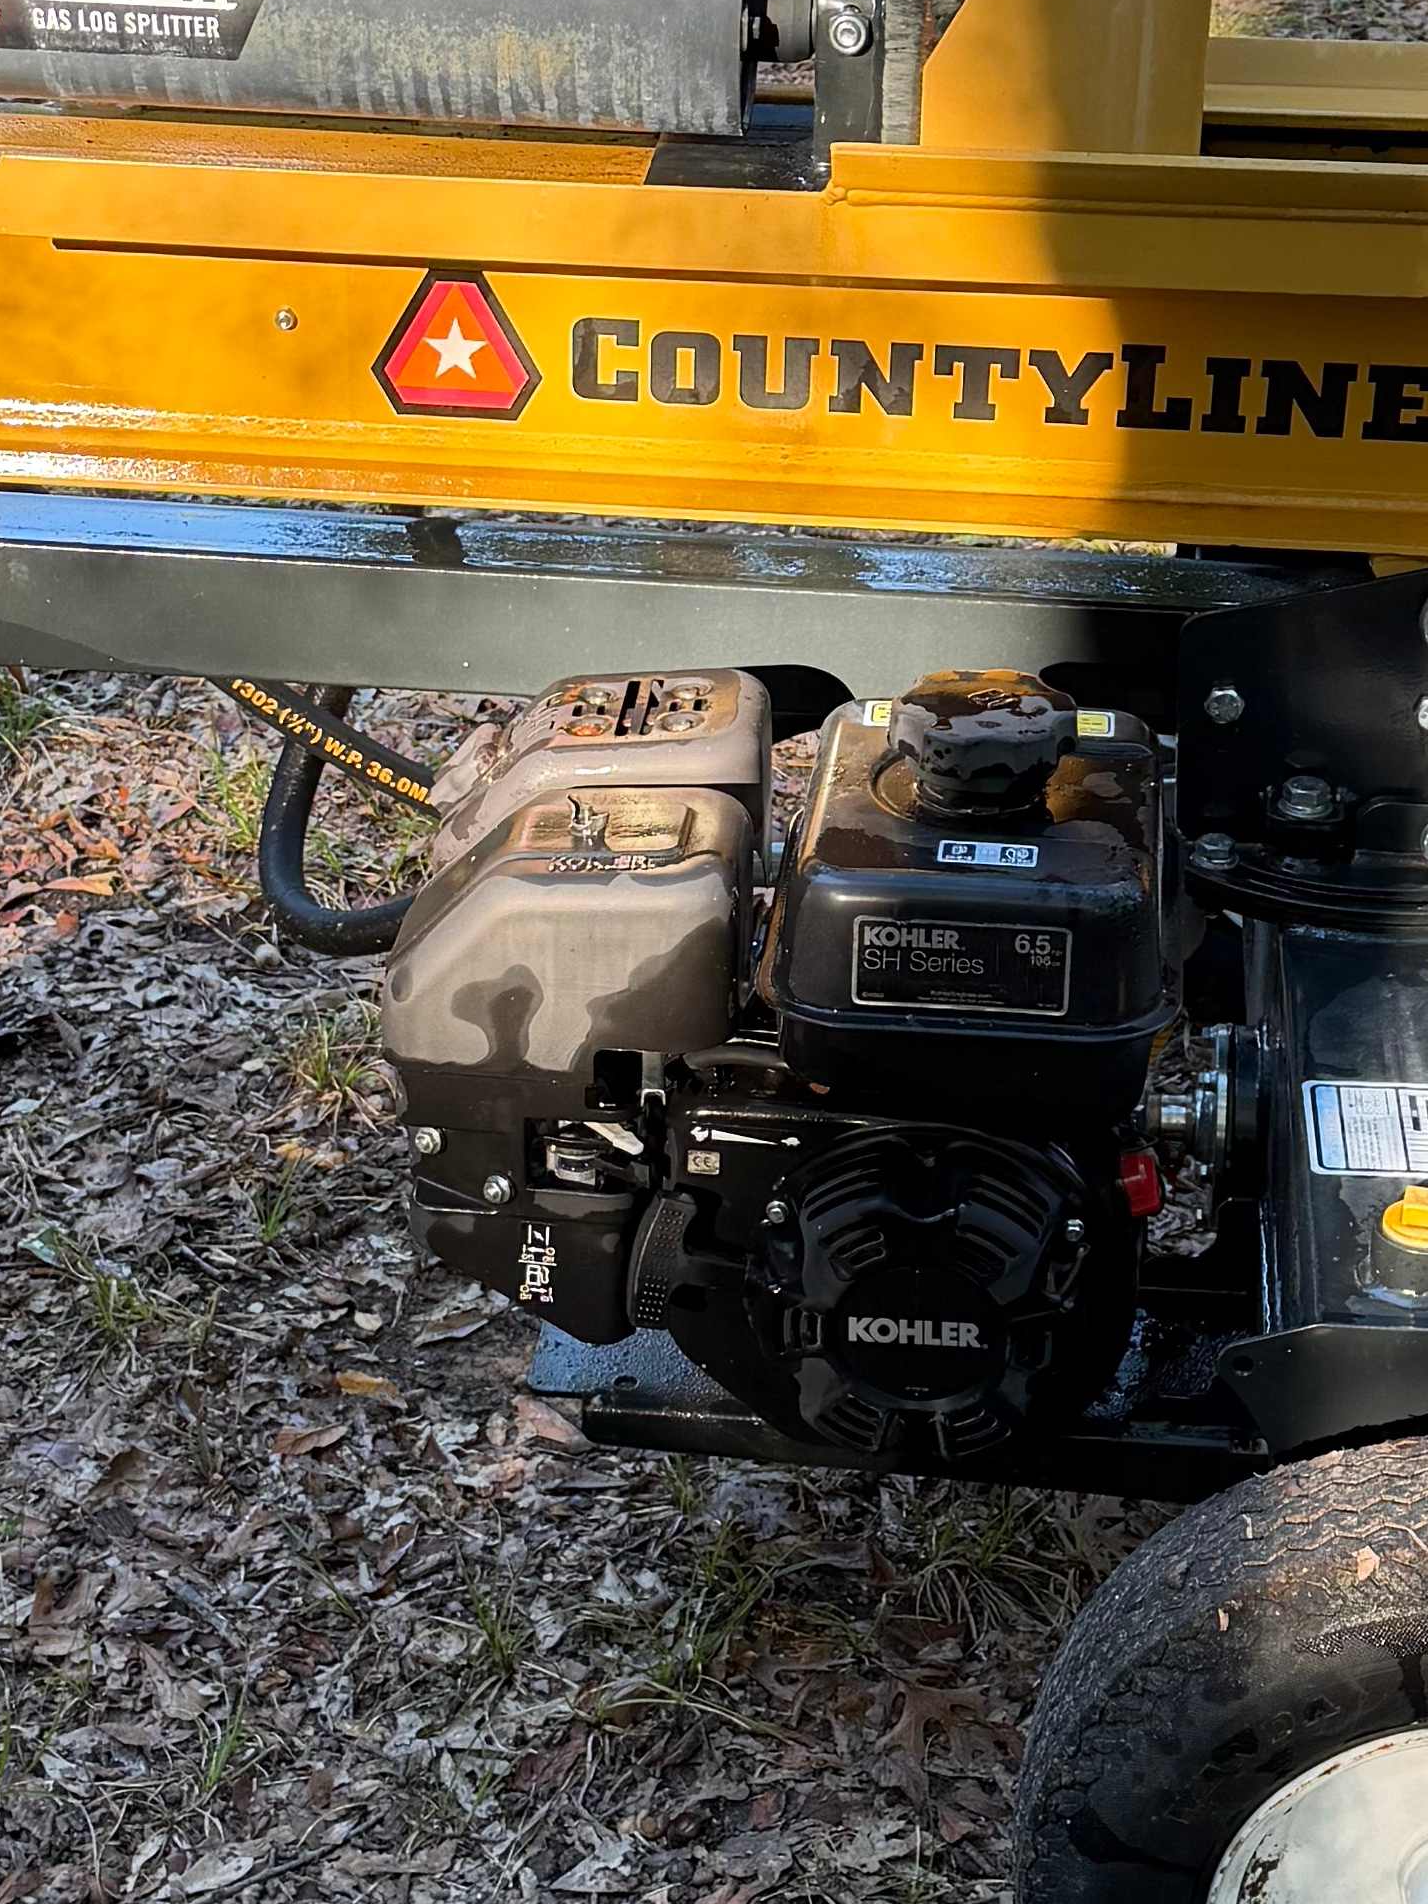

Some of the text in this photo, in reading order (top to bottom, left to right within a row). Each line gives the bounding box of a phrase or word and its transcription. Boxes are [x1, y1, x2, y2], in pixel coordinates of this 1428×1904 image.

[31, 7, 221, 39] GAS LOG SPLITTER
[323, 736, 364, 770] W.P.
[863, 926, 1052, 955] KOHLER 6.5
[862, 948, 901, 972] SH
[909, 950, 985, 975] Series
[847, 1316, 980, 1350] KOHLER
